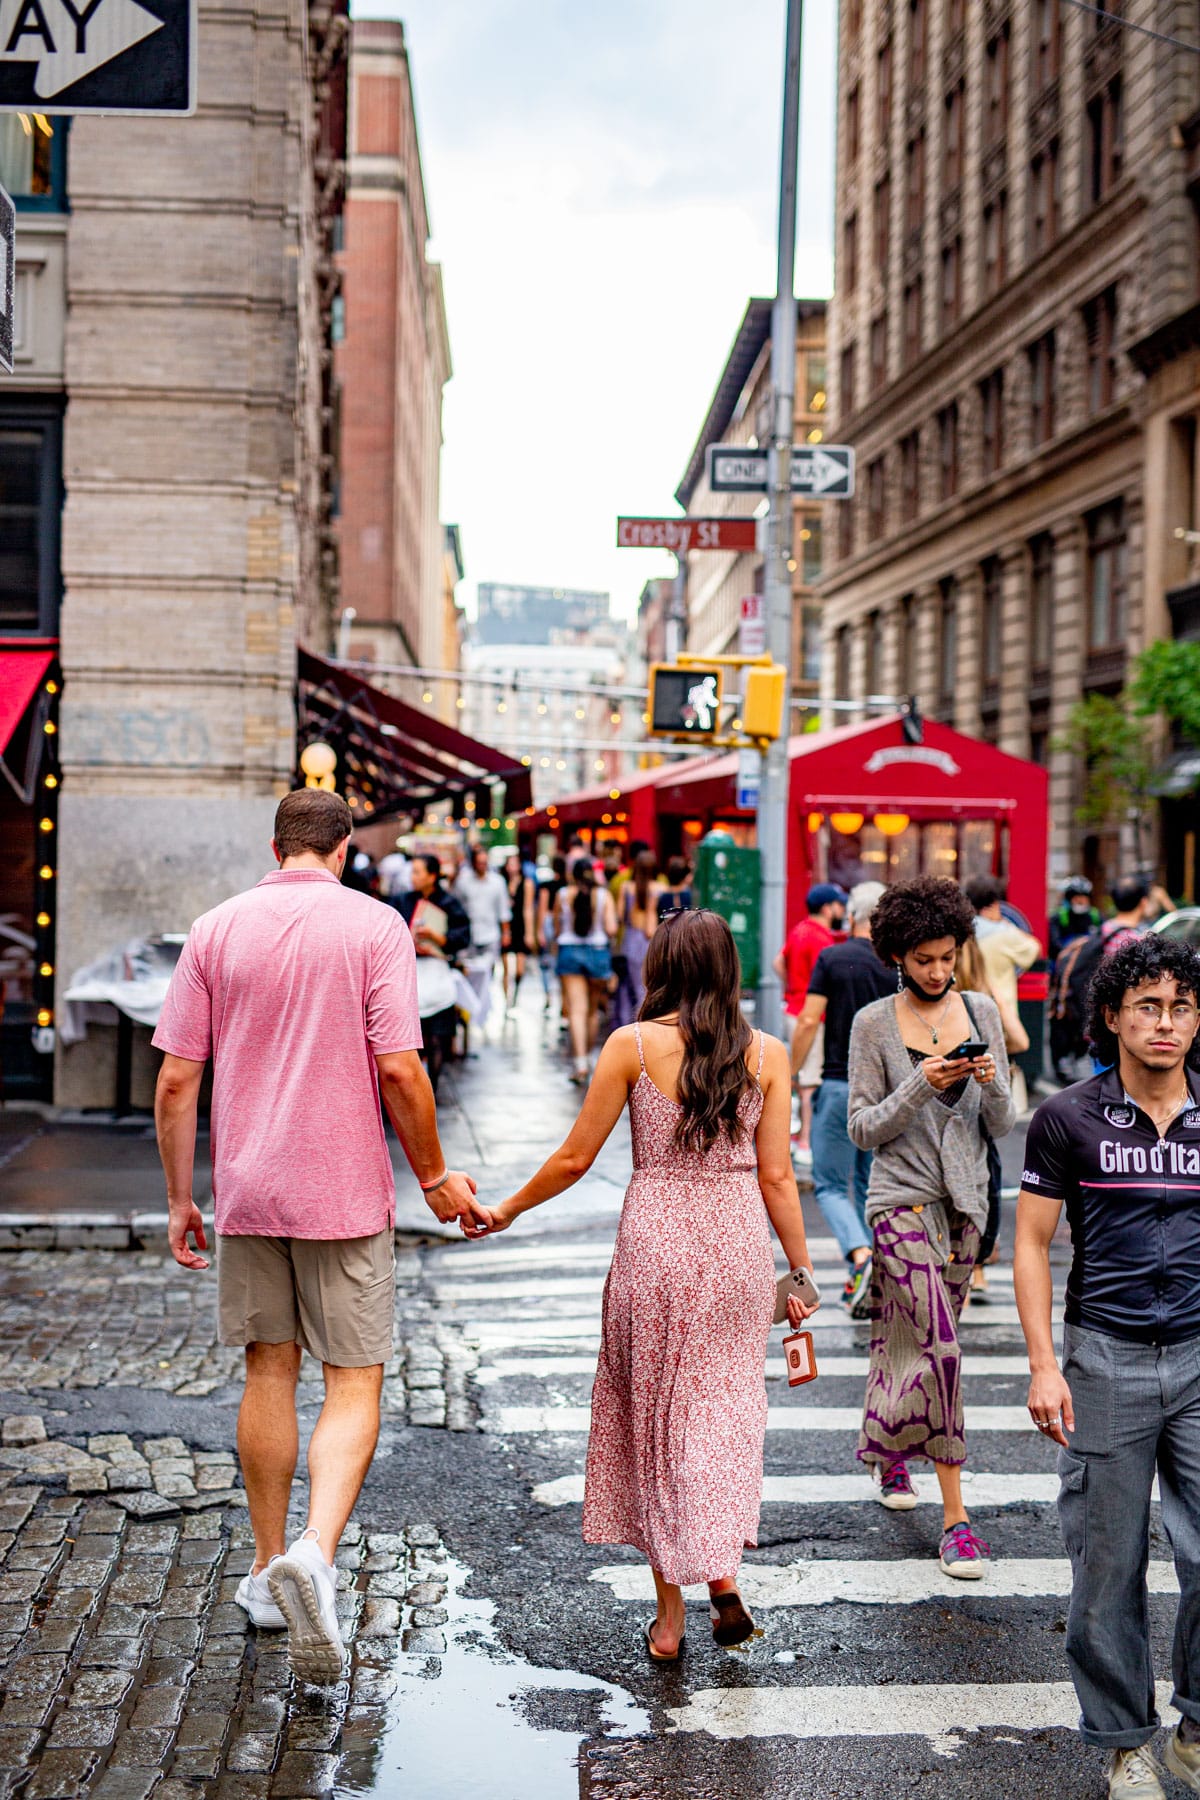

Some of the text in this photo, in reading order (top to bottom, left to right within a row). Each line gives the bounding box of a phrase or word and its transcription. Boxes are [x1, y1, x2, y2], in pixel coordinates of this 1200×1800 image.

[0, 0, 100, 53] AY
[721, 462, 762, 480] ONE
[619, 521, 720, 550] Crosby St
[1100, 1139, 1200, 1176] Giro d'Ita
